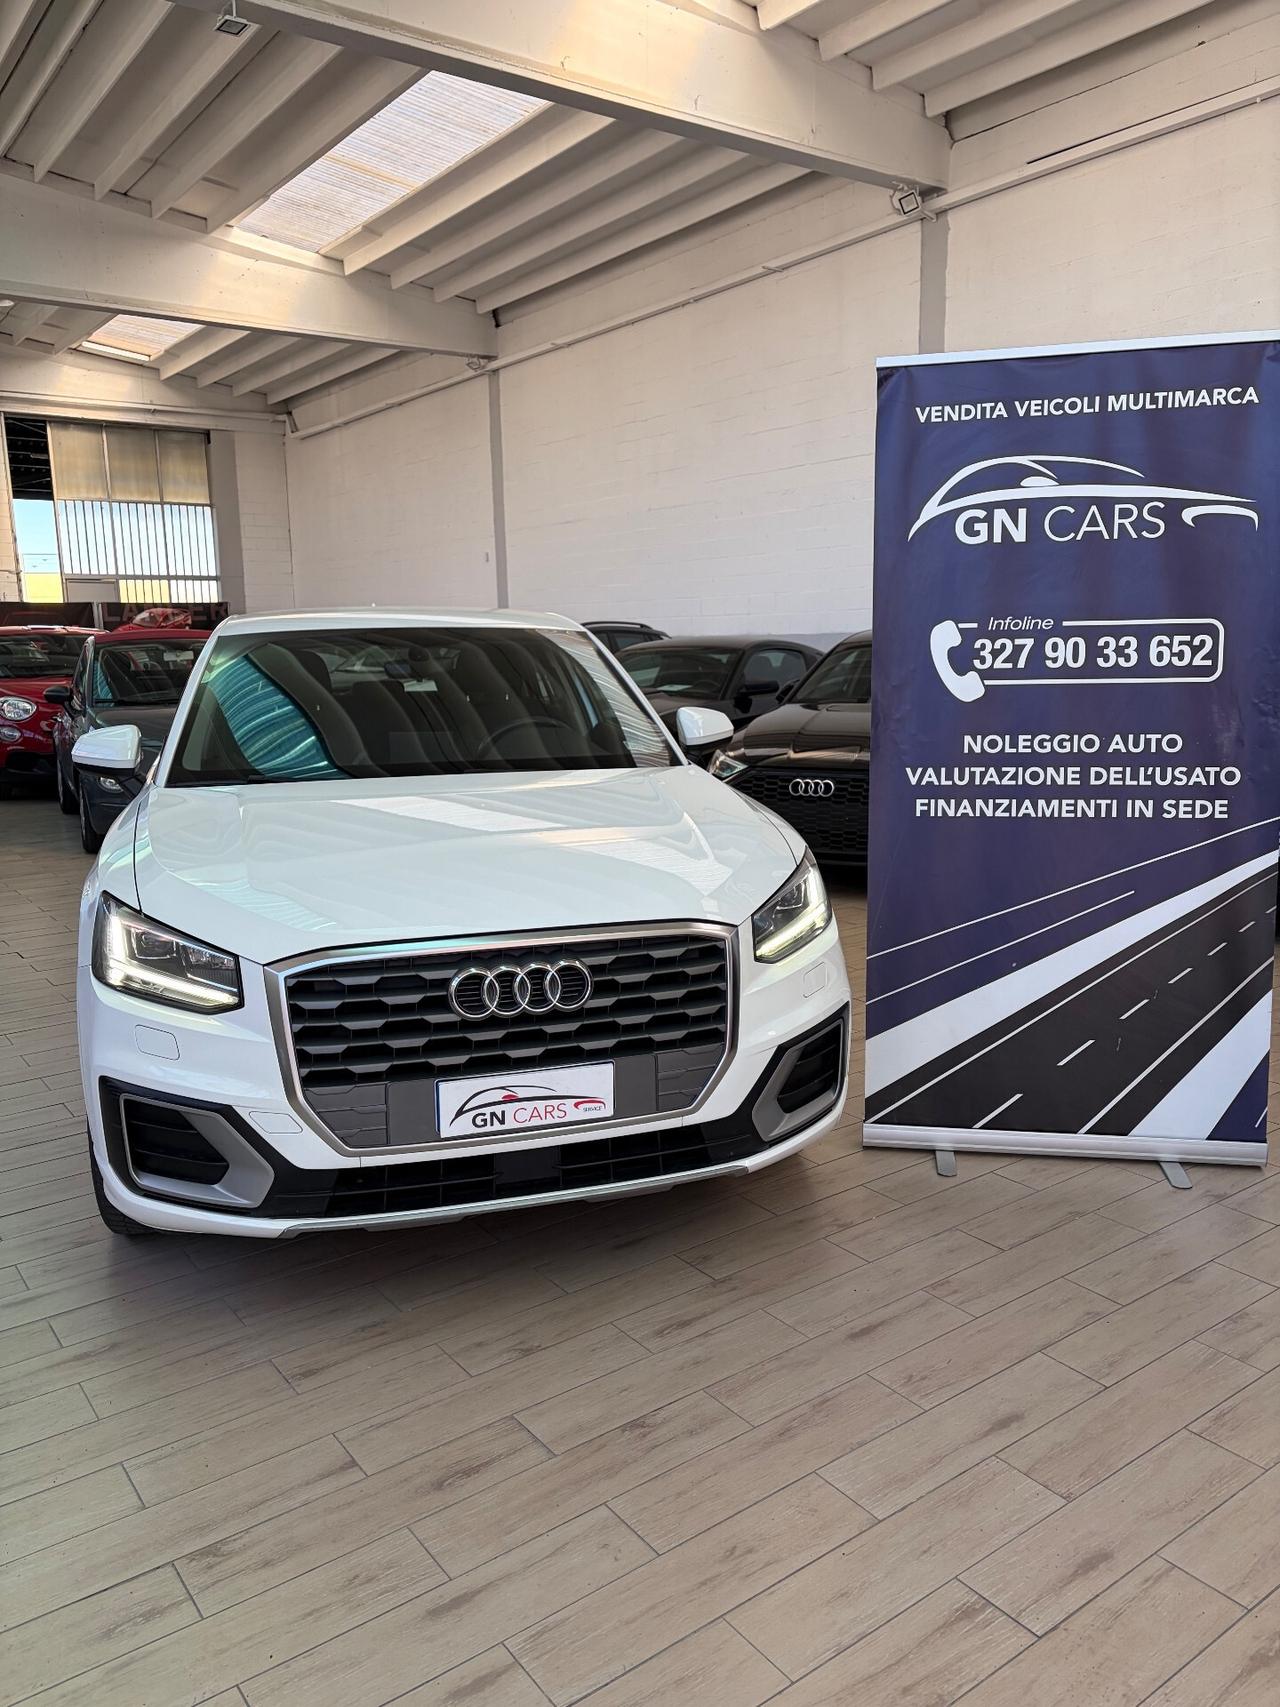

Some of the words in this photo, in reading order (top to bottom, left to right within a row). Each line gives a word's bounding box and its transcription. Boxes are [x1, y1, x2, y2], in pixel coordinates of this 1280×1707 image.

[915, 401, 1009, 423] VENDITA
[1014, 395, 1101, 417] VEICOLI
[1107, 386, 1260, 412] MULTIMARCA
[954, 507, 1027, 545] GN
[1043, 501, 1166, 542] CARS
[988, 615, 1054, 631] Infoline
[972, 637, 1035, 670] 327
[1044, 636, 1086, 669] 90
[1096, 635, 1139, 668] 33
[1149, 634, 1213, 667] 652
[963, 733, 1101, 754] NOLEGGIO
[1107, 733, 1183, 753] AUTO
[905, 766, 1081, 786] VALUTAZIONE
[1089, 766, 1242, 786] DELL'USATO
[915, 798, 1118, 818] FINANZIAMENTI
[1126, 798, 1154, 818] IN
[1161, 798, 1229, 819] SEDE
[471, 1110, 506, 1129] GN
[513, 1102, 568, 1124] CARS
